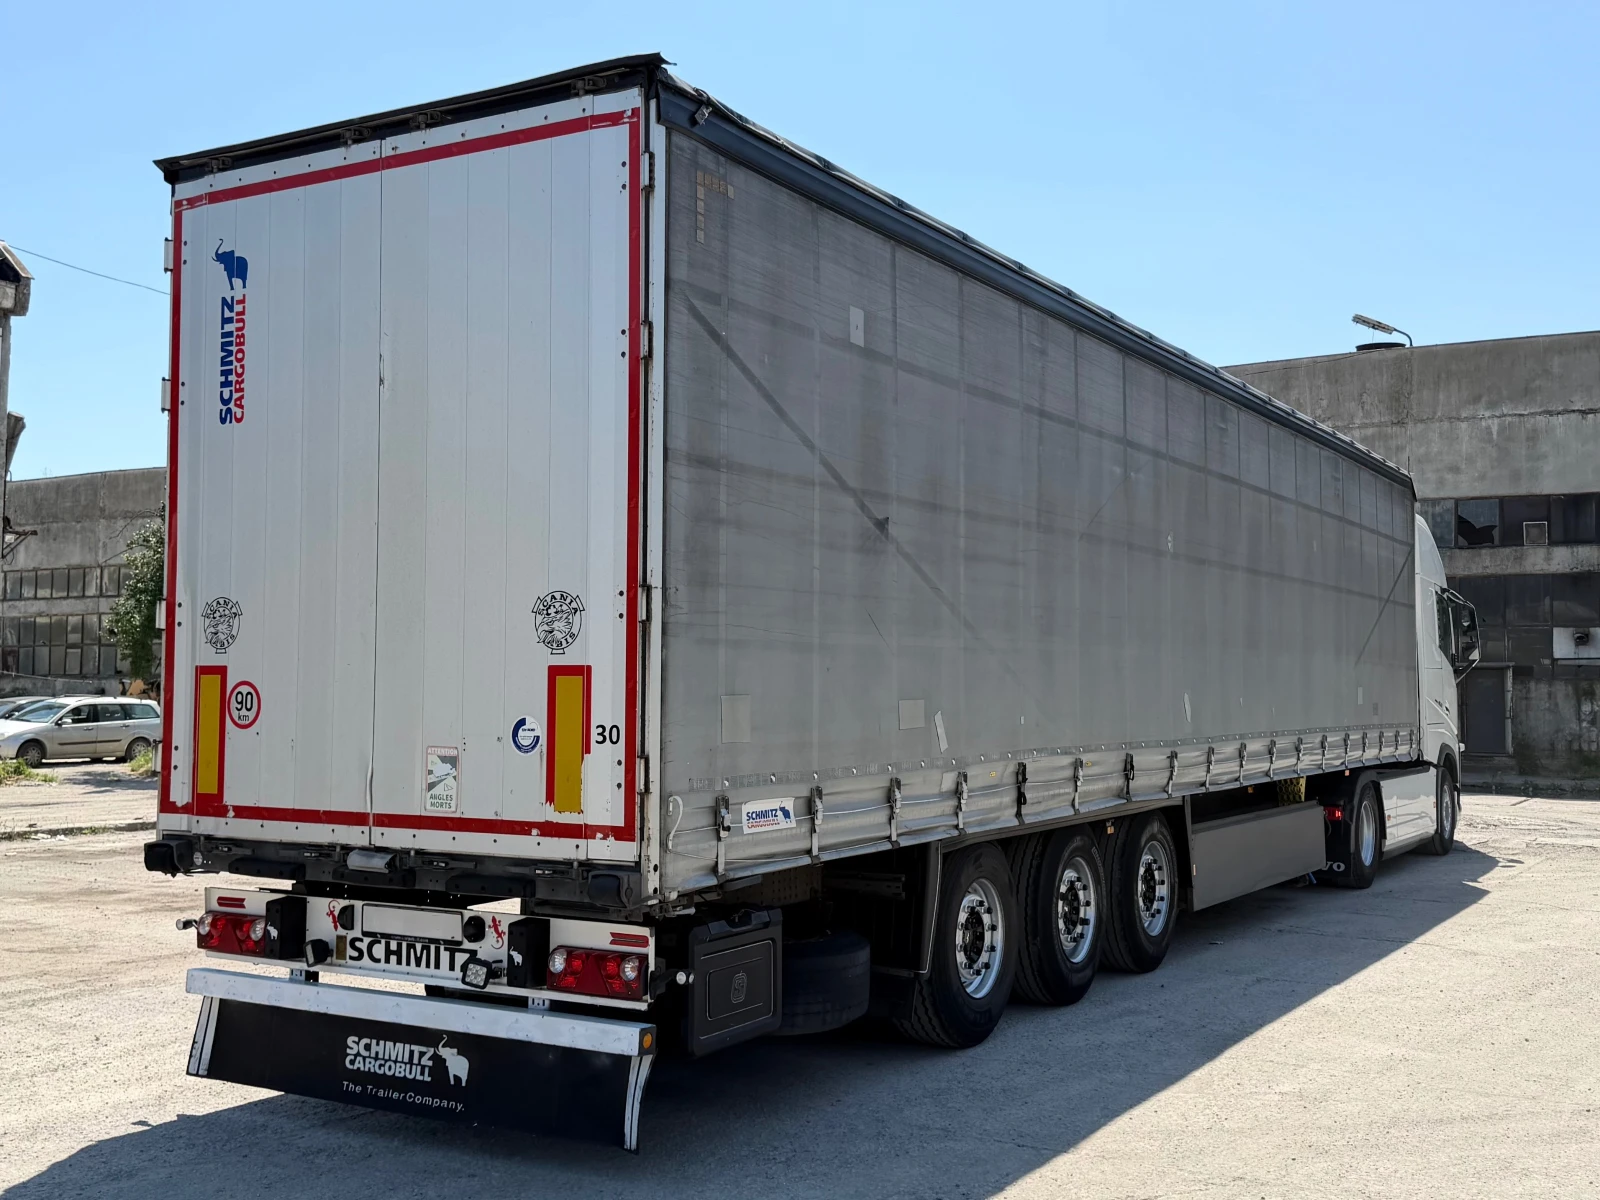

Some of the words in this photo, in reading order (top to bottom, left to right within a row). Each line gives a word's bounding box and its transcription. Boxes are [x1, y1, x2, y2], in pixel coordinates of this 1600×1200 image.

[219, 295, 235, 425] SCHMITZ
[233, 293, 247, 424] CARGOBULL
[537, 593, 579, 617] SCANIA
[235, 690, 254, 712] 90
[237, 712, 250, 722] km
[594, 724, 621, 745] 30
[429, 793, 454, 802] ANGLES
[429, 801, 453, 810] MORTS
[746, 808, 779, 821] SCHMITZ
[346, 1035, 435, 1067] SCHMITZ
[345, 1054, 432, 1082] CARGOBULL
[342, 1080, 362, 1094] The
